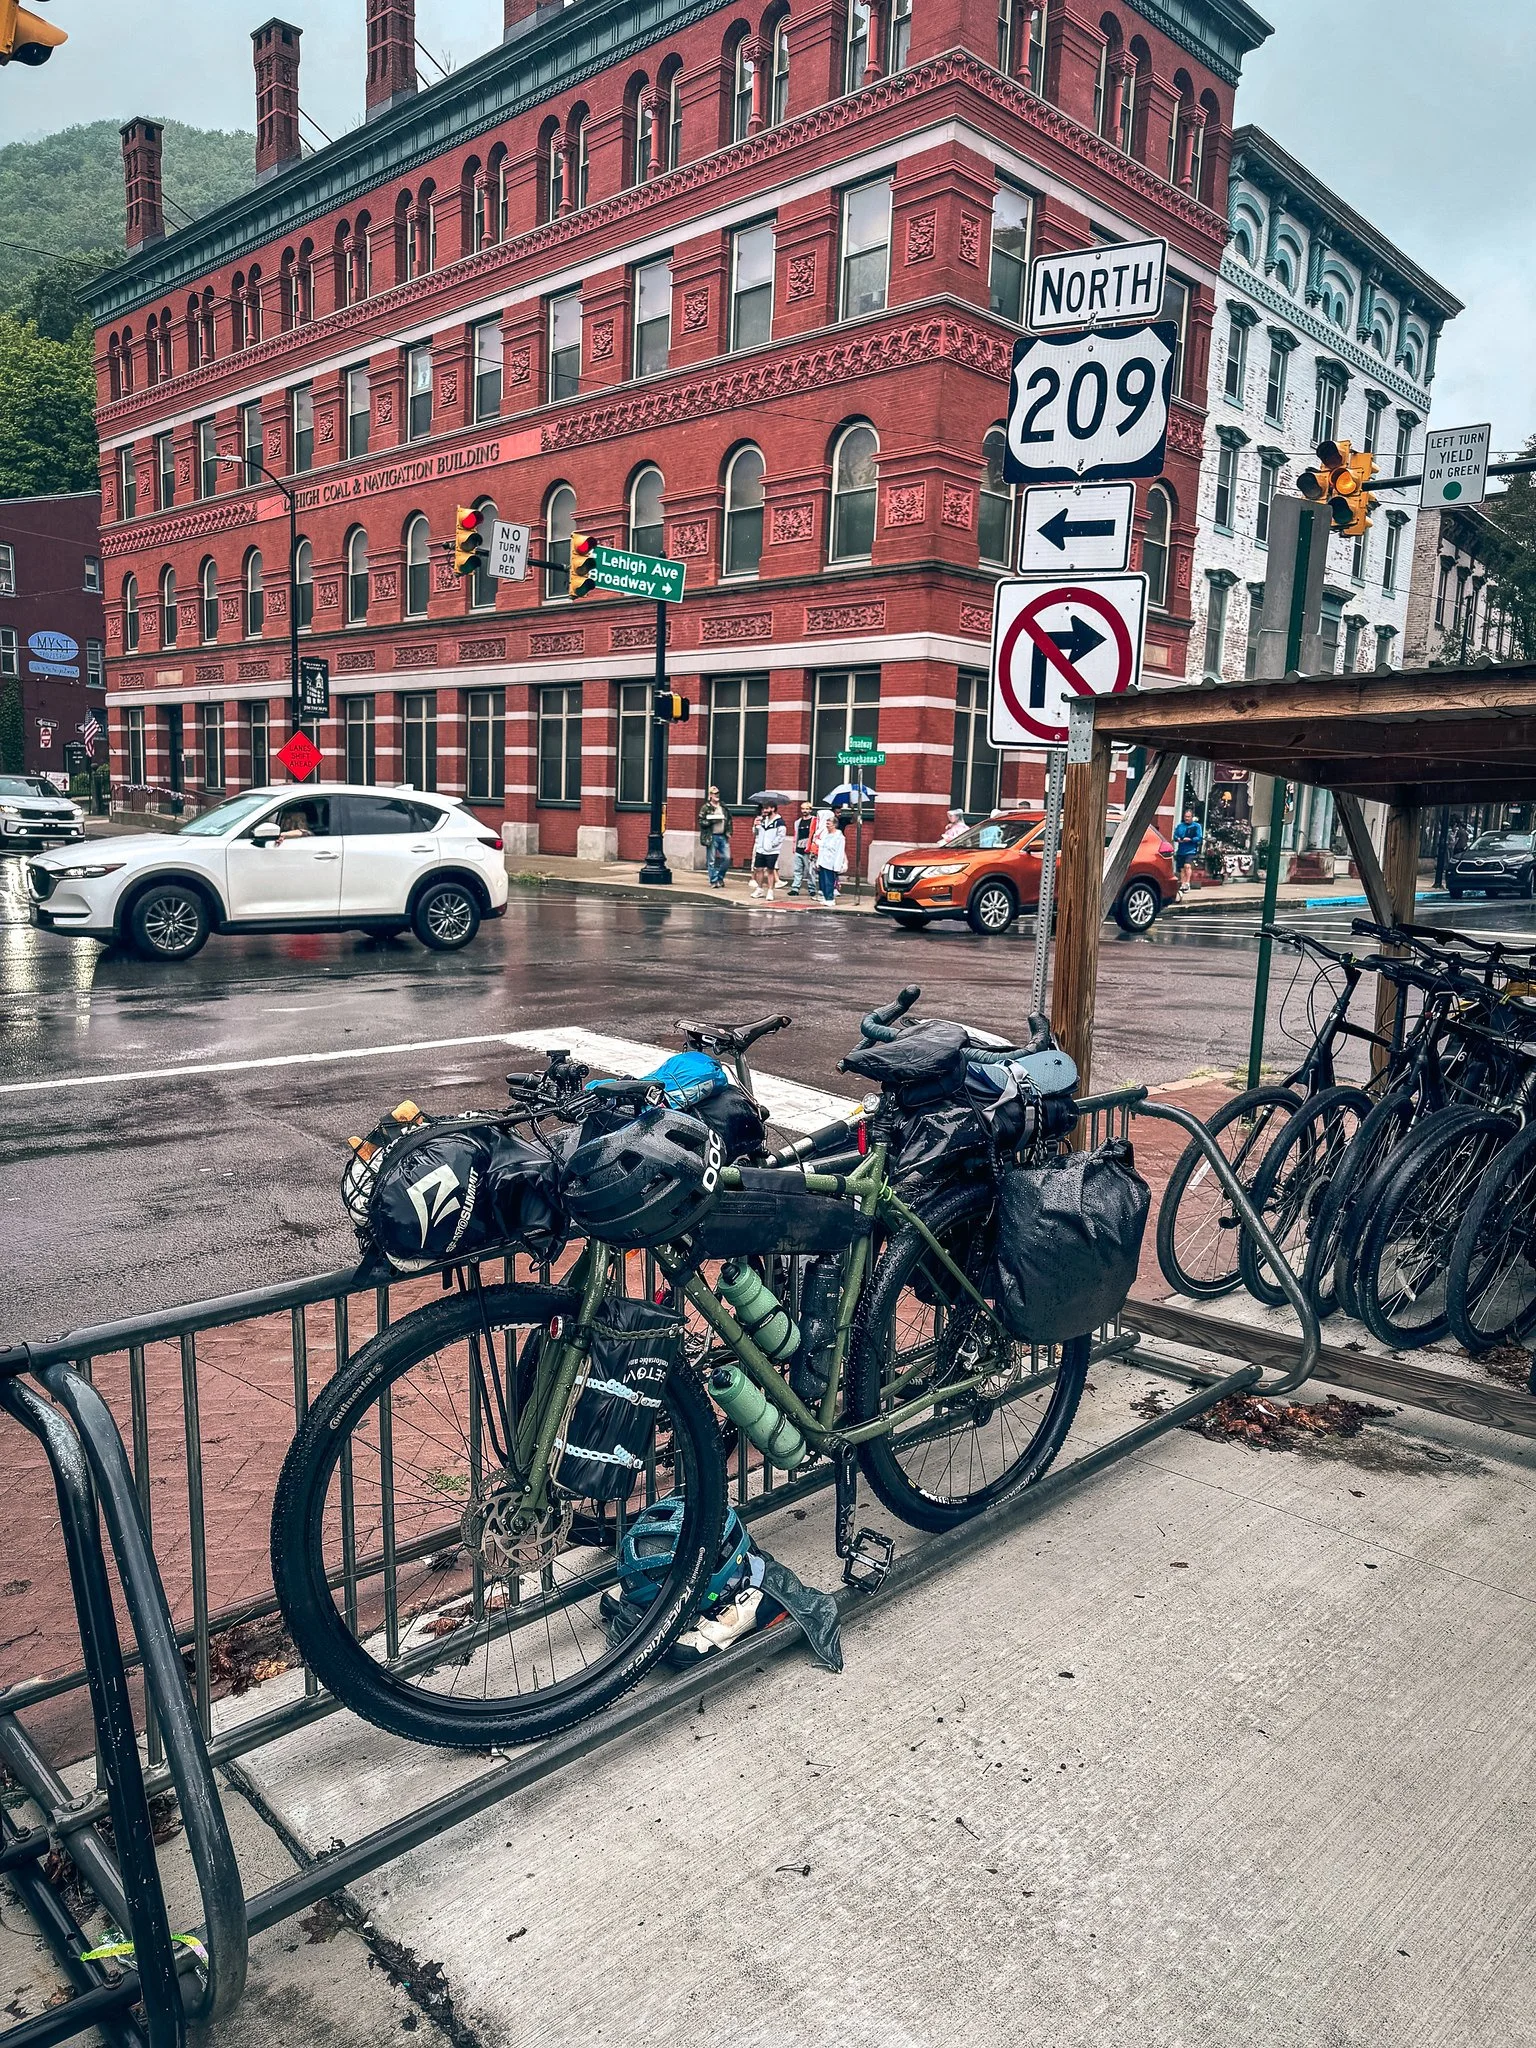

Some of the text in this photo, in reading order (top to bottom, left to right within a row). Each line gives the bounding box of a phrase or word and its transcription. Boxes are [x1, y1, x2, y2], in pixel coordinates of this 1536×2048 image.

[1039, 261, 1154, 316] NORTH
[1020, 356, 1156, 444] 209
[1431, 432, 1485, 449] LEFT TURN
[1439, 448, 1473, 464] YIELD
[323, 483, 350, 502] COAL
[352, 479, 361, 494] &
[363, 464, 434, 493] NAVIGATION
[437, 442, 500, 475] BUILDING
[1429, 464, 1480, 479] ON GREEN
[501, 526, 521, 542] NO
[499, 541, 521, 553] TURN
[502, 553, 515, 564] ON
[601, 552, 679, 580] Lehigh Ave
[499, 564, 516, 576] RED
[589, 568, 657, 595] Broadway
[37, 635, 72, 653] MYST
[289, 744, 311, 752] LANES
[849, 737, 872, 750] Broadway
[291, 752, 310, 760] SHIFT
[837, 752, 877, 764] Susquehanna
[289, 760, 312, 768] AHEAD
[1457, 1051, 1467, 1062] 6
[329, 1371, 377, 1430] Continental
